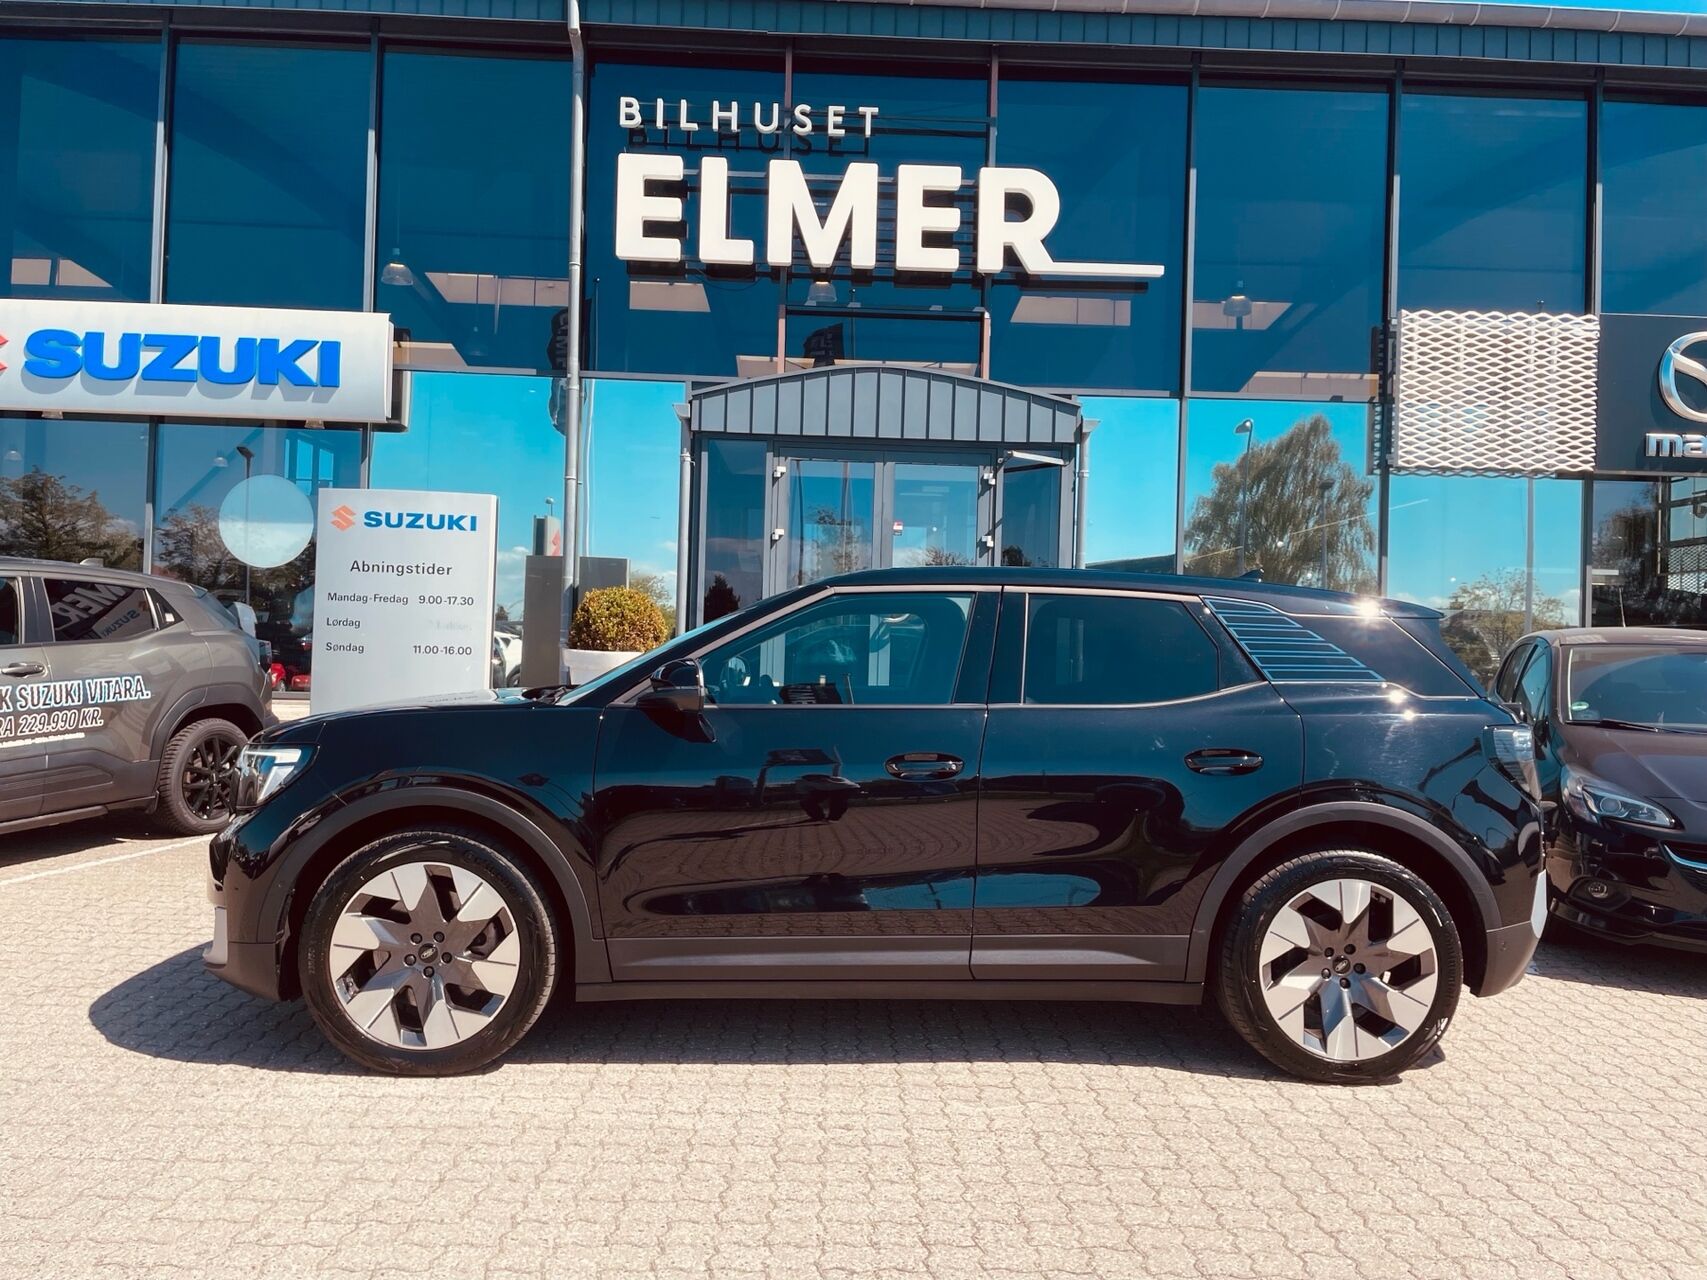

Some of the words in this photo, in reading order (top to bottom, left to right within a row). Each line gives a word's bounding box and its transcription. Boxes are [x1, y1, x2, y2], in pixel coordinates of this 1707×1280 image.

[619, 96, 879, 136] BILHUSET
[615, 152, 1165, 276] ELMER
[24, 329, 341, 388] SUZUKI
[363, 510, 478, 532] SUZUKI
[326, 617, 361, 629] Lørdag
[325, 642, 365, 654] Søndag
[17, 681, 82, 710] SUZUKI
[86, 675, 151, 703] VITARA.
[18, 709, 78, 736] 229.990
[80, 707, 104, 728] KR.
